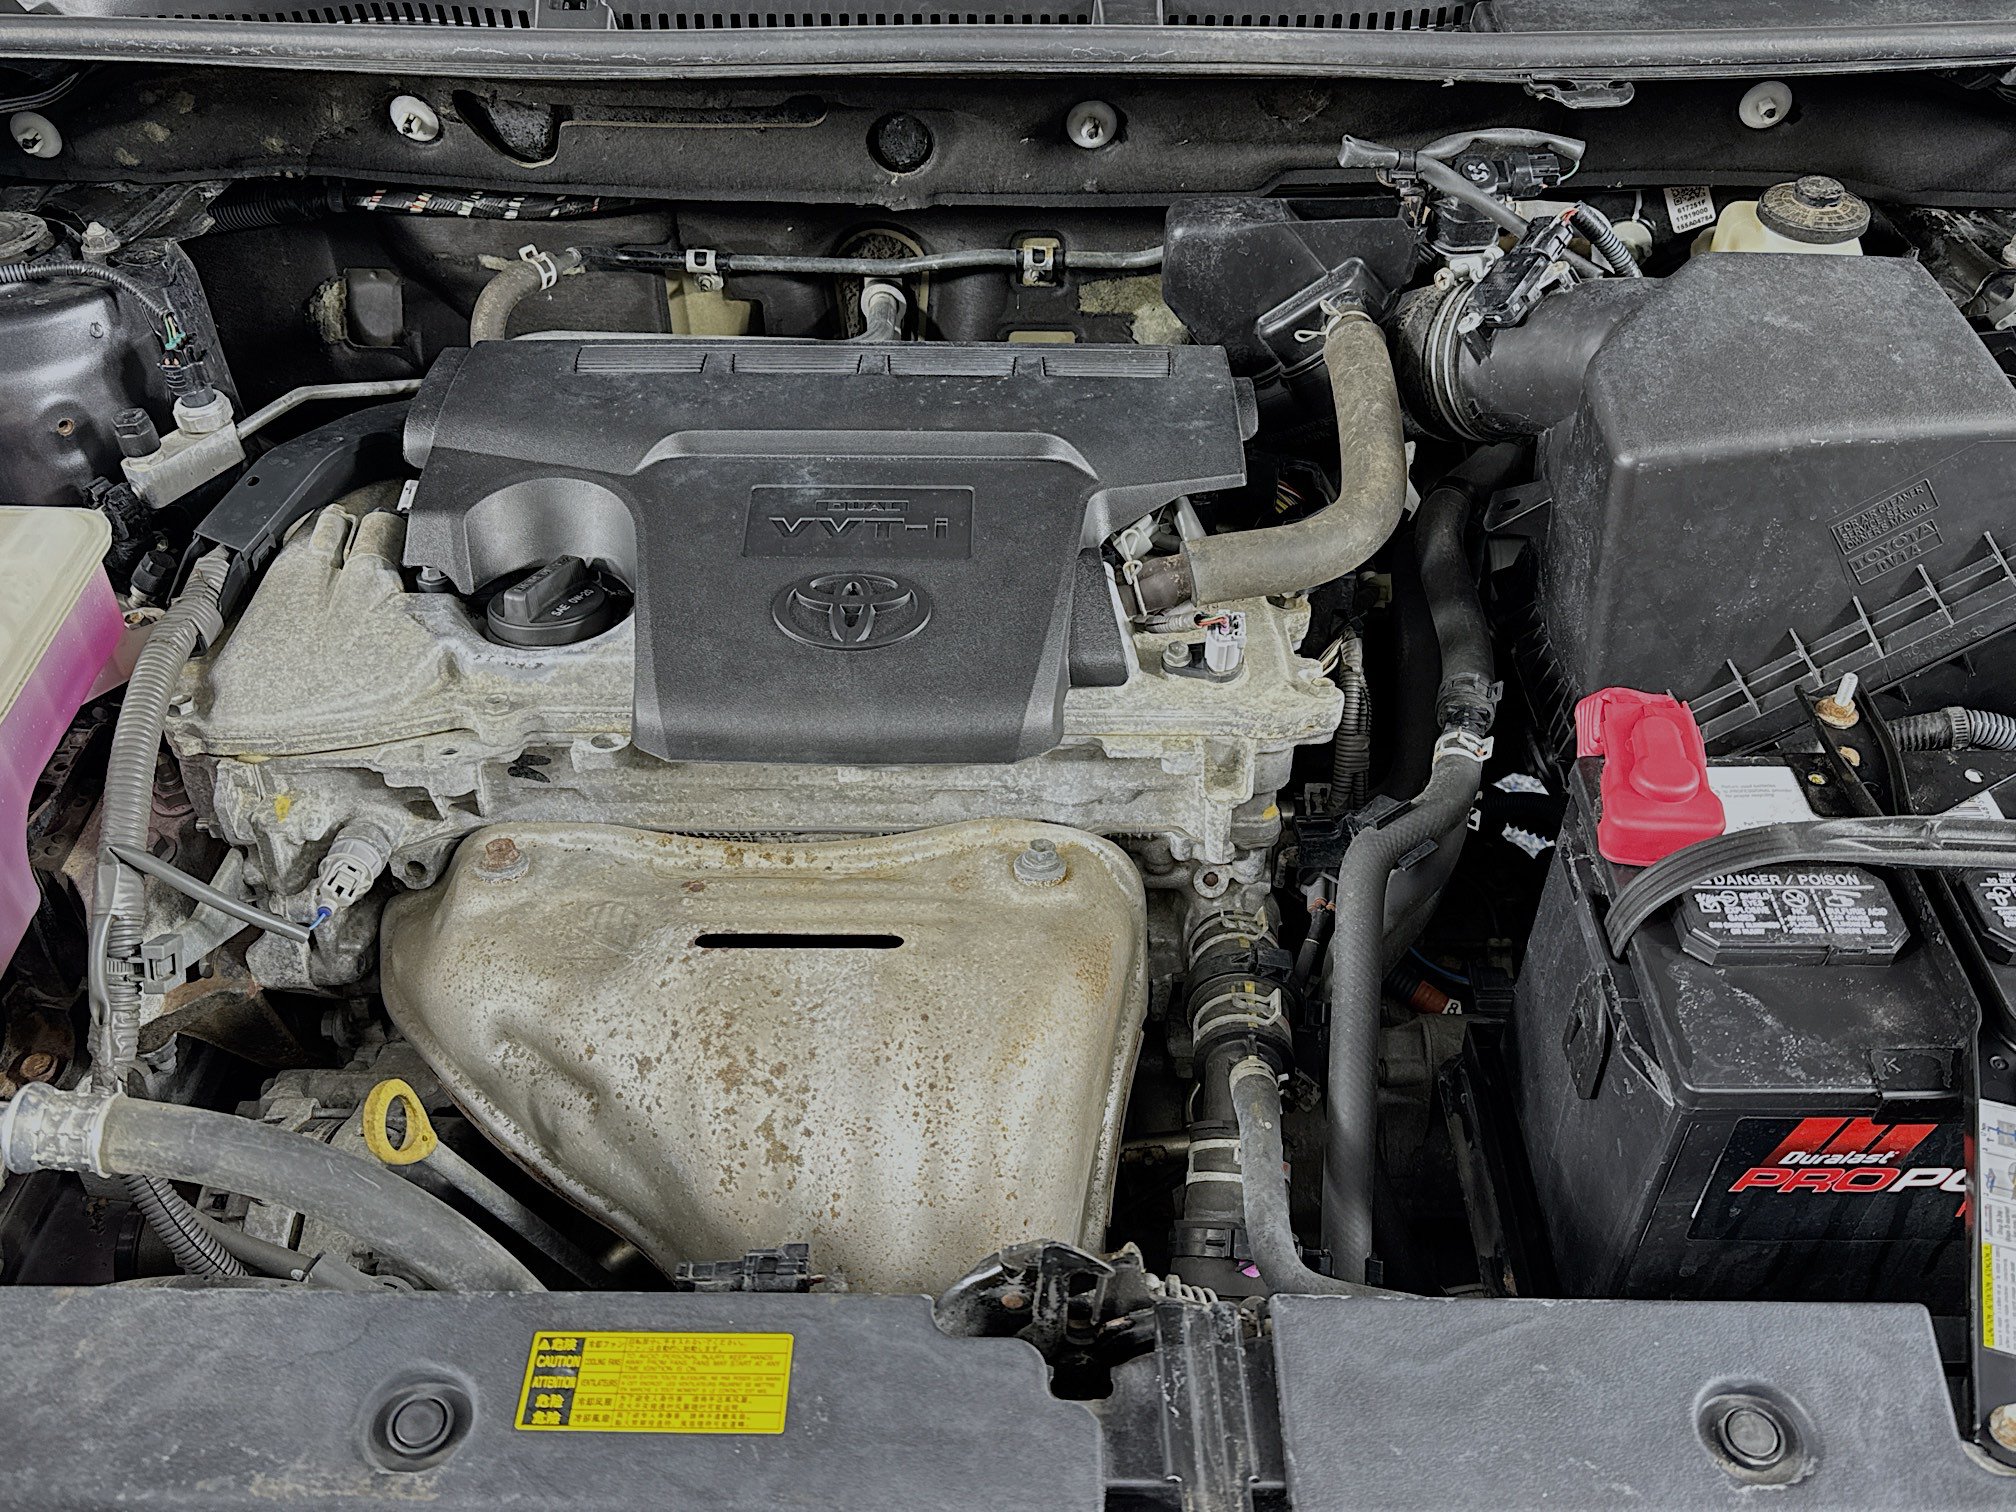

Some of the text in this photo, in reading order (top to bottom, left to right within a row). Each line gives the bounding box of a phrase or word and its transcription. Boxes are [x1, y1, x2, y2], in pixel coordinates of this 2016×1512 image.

[825, 500, 904, 511] DUAL
[1837, 485, 1924, 535] FOR AIR CLEANER
[1887, 503, 1907, 520] SEE
[769, 517, 948, 538] VVT-i
[1845, 521, 1889, 550] OWNER'S
[1853, 522, 1936, 569] TOYOTA
[550, 604, 571, 617] SAE
[1713, 874, 1782, 886] DANGER
[1797, 874, 1860, 886] POISON
[1778, 1151, 1896, 1165] Duralast
[536, 1355, 581, 1368] CAUTION
[532, 1376, 577, 1388] ATTENTION
